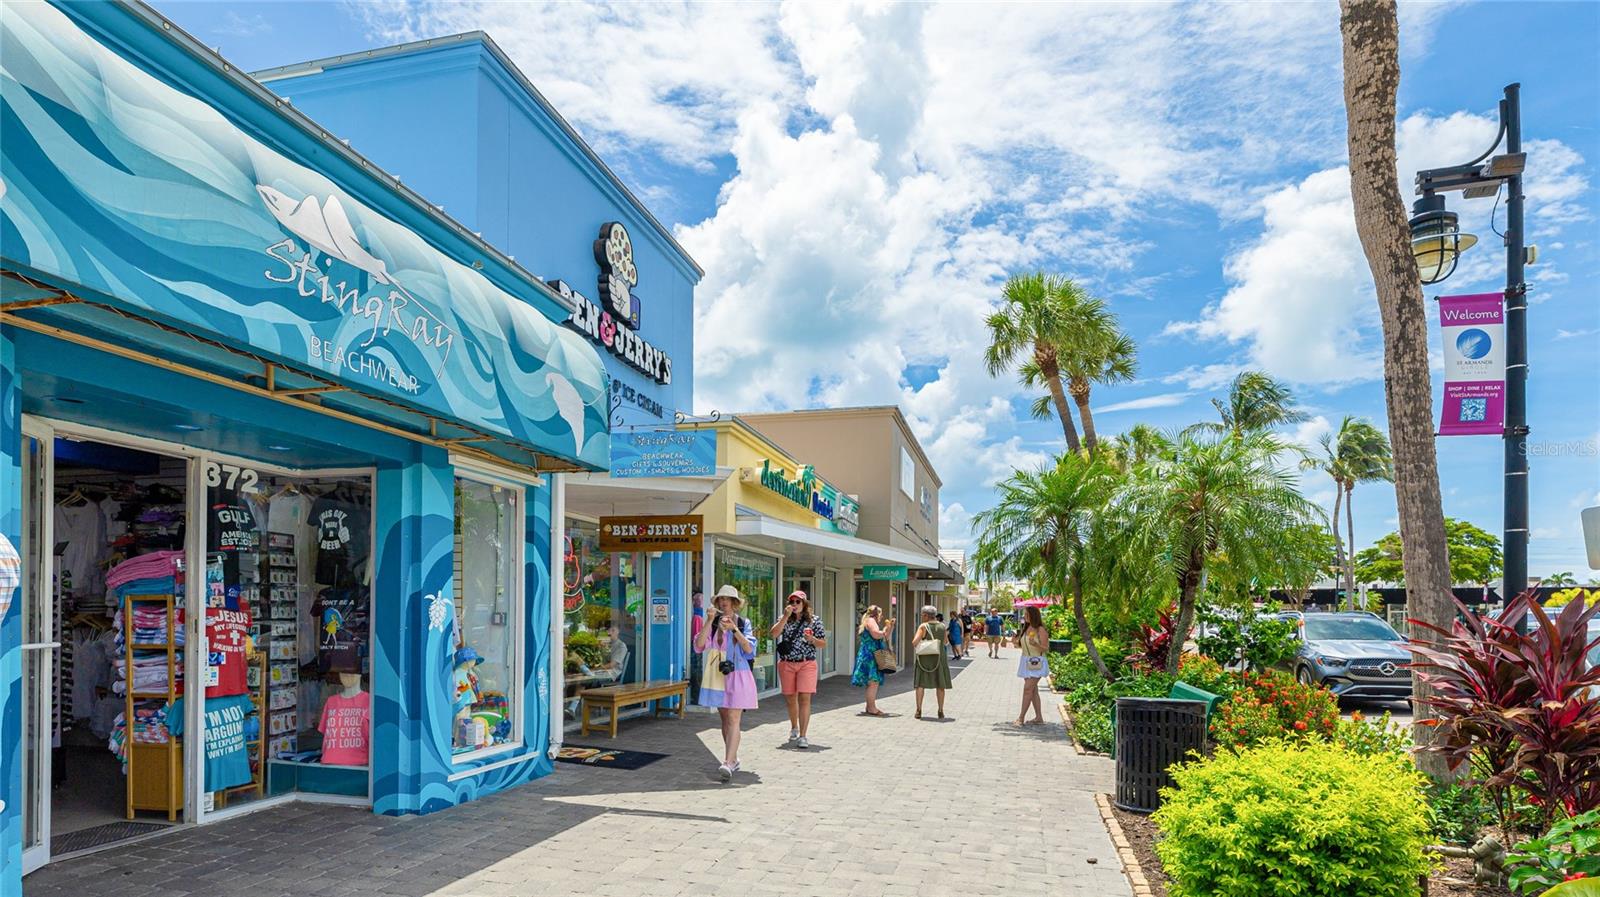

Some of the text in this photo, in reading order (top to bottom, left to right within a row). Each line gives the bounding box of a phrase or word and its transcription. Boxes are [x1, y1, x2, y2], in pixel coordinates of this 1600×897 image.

[264, 238, 453, 380] StingRay
[1444, 309, 1500, 321] Welcome
[614, 320, 673, 386] JERRY'S
[310, 335, 421, 395] BEACHWEAR
[622, 383, 636, 403] ICE
[637, 393, 663, 419] CREAM
[632, 460, 651, 468] GIFTS
[659, 459, 694, 467] SOUVENIRS
[206, 461, 259, 494] 372
[615, 468, 641, 476] CUSTOM
[218, 509, 251, 524] GULF
[612, 524, 637, 536] BEN
[647, 523, 698, 536] JERRY'S
[320, 540, 341, 550] BEER
[214, 624, 225, 633] MY
[338, 708, 368, 717] SORRY
[340, 727, 362, 738] EYES
[206, 742, 217, 751] I'M
[207, 749, 224, 760] WHY
